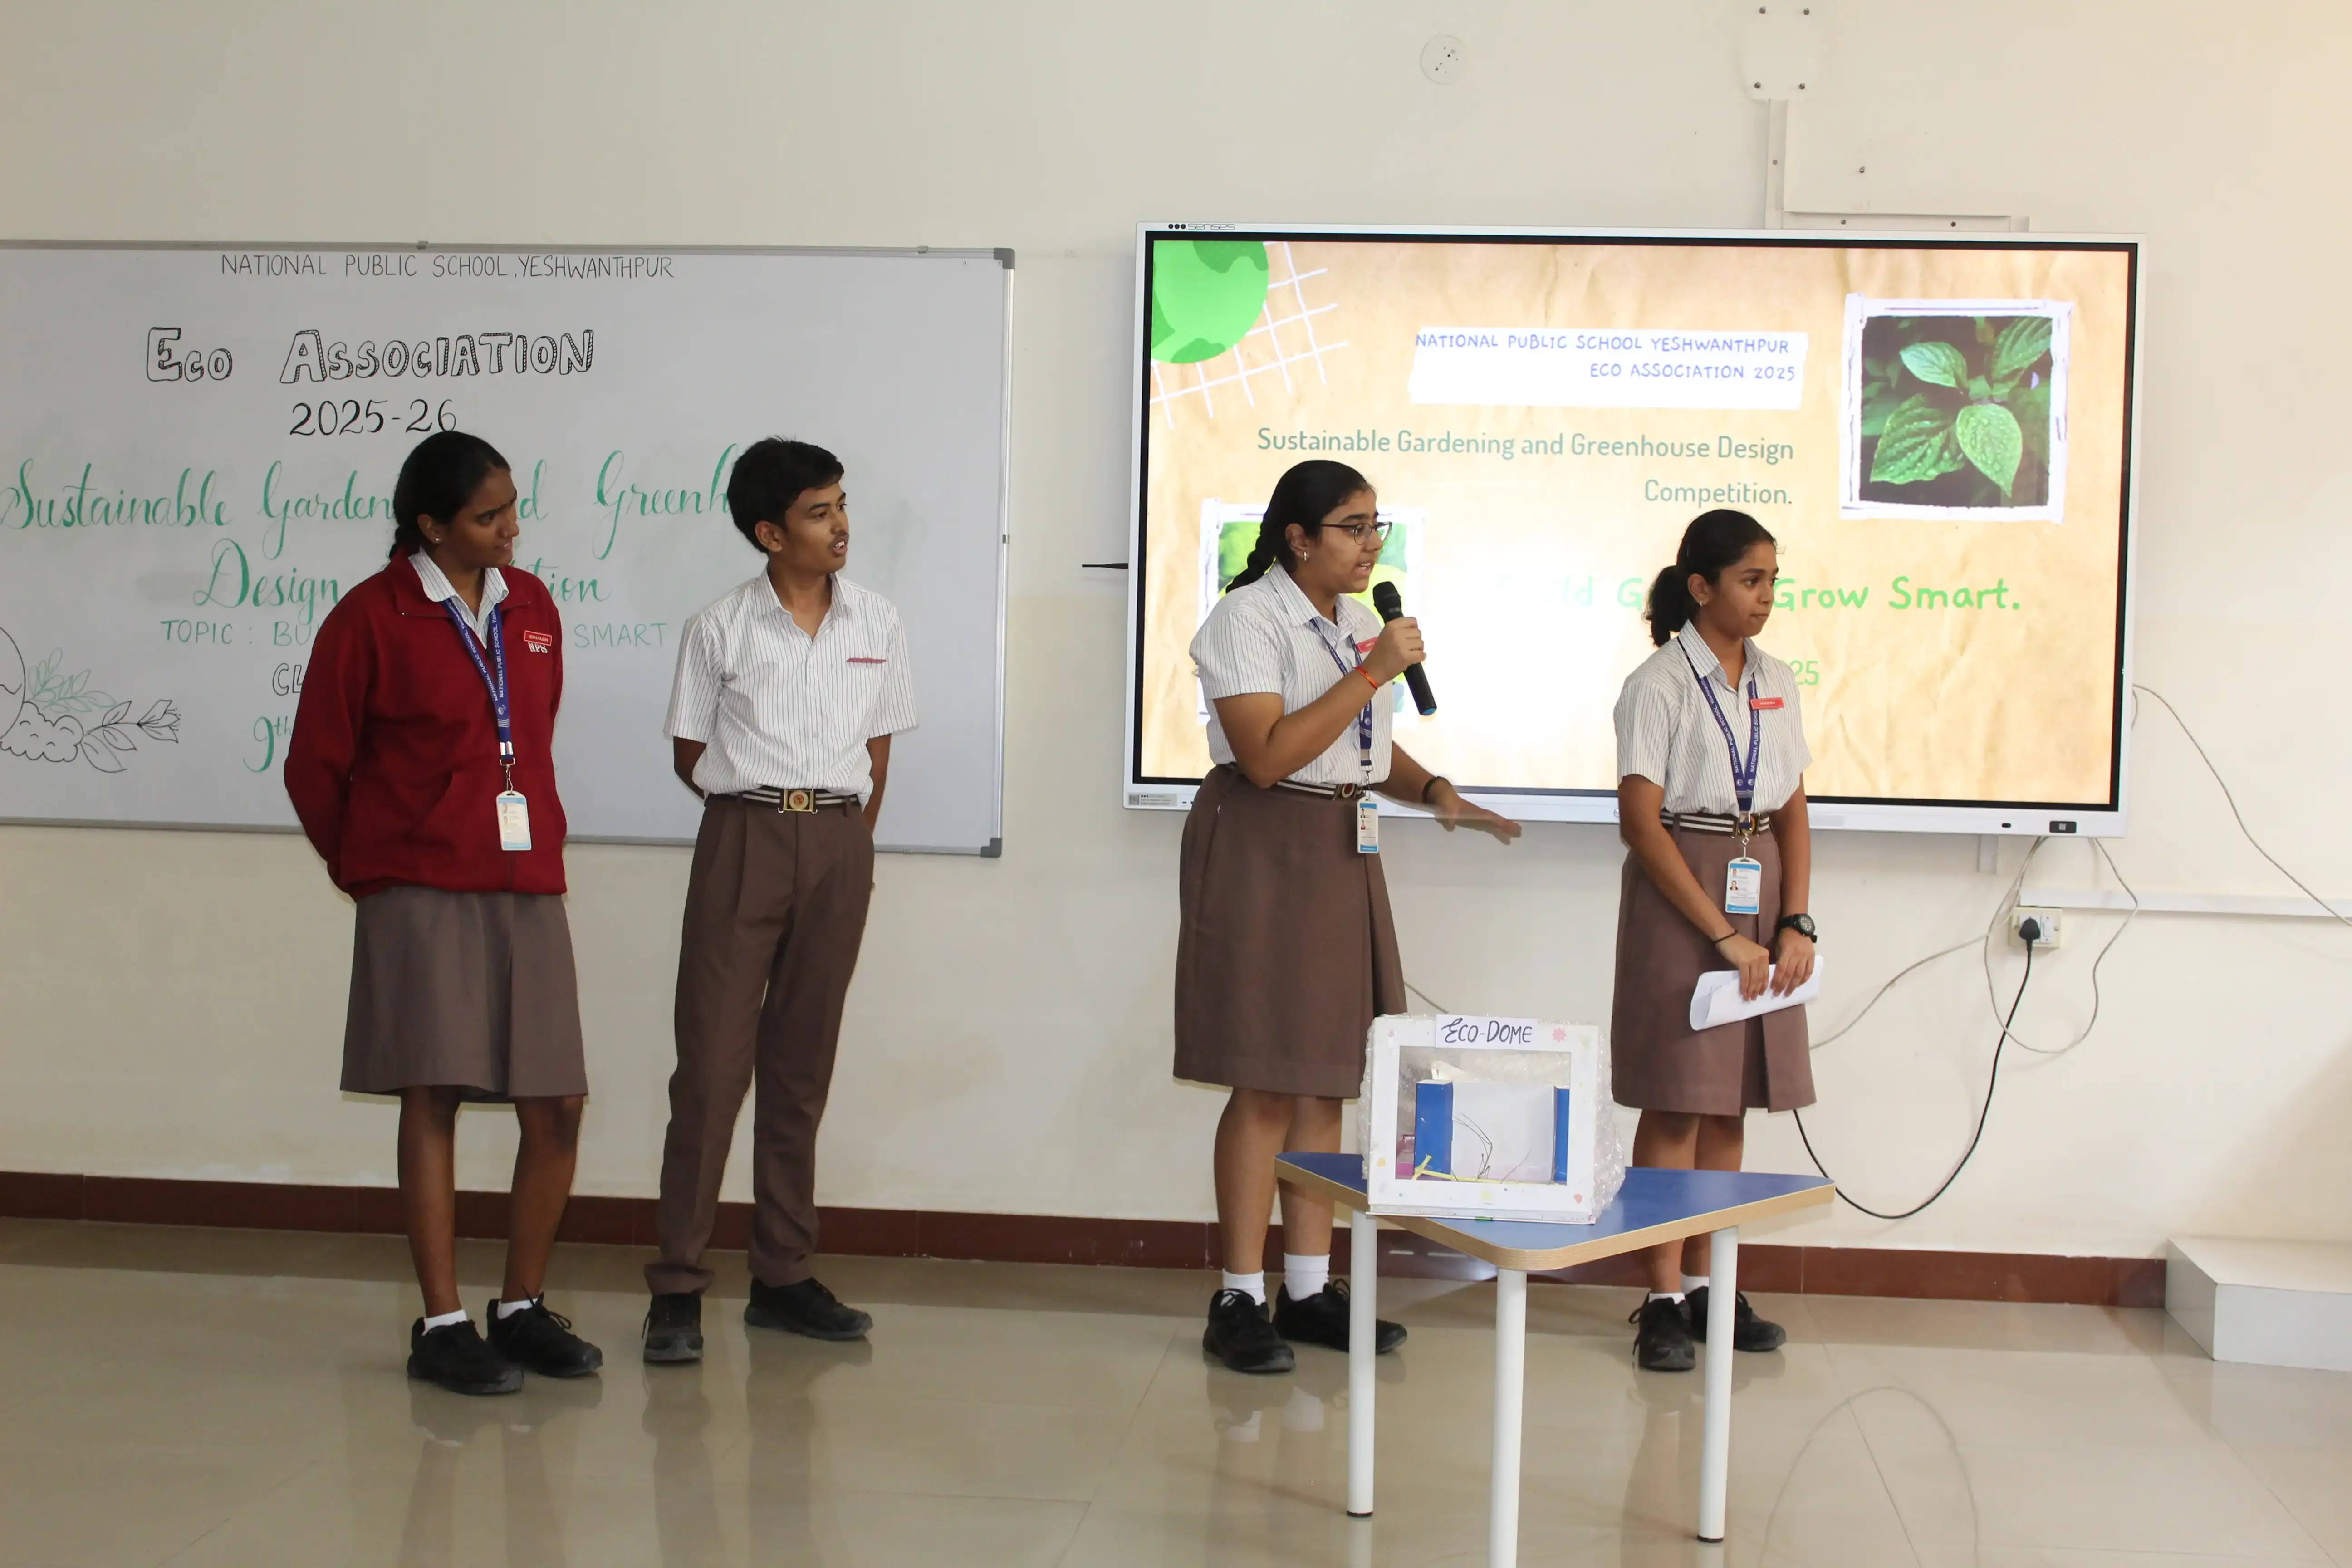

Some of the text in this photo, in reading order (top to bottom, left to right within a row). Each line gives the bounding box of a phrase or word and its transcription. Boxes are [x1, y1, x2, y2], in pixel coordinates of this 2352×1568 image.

[222, 254, 327, 276] NATIONAL
[345, 254, 417, 277] PUBLIC
[1415, 333, 1788, 354] NATIONAL PUBLIC SCHOOL YESHWANTHPUR
[1590, 363, 1795, 382] ECO ASSOCIATION 2025
[289, 399, 456, 436] 2025-26
[1257, 427, 1794, 466] Sustainable Gardening and Greenhouse Design
[0, 458, 233, 529] Sustainable
[256, 460, 394, 561] Garden
[593, 443, 730, 561] Greenh
[1645, 479, 1793, 508] Competition.
[193, 538, 340, 626] Design
[1773, 575, 2021, 612] Grow Smart.
[528, 642, 548, 653] NPS
[574, 622, 668, 648] SMART
[475, 654, 487, 673] PUBLIC
[485, 674, 499, 701] NATIONAL
[1724, 726, 1734, 746] PUBLIC
[1731, 746, 1739, 773] NATIONAL
[1750, 746, 1758, 773] NATIONAL
[1441, 1017, 1533, 1044] ECO-DOME
